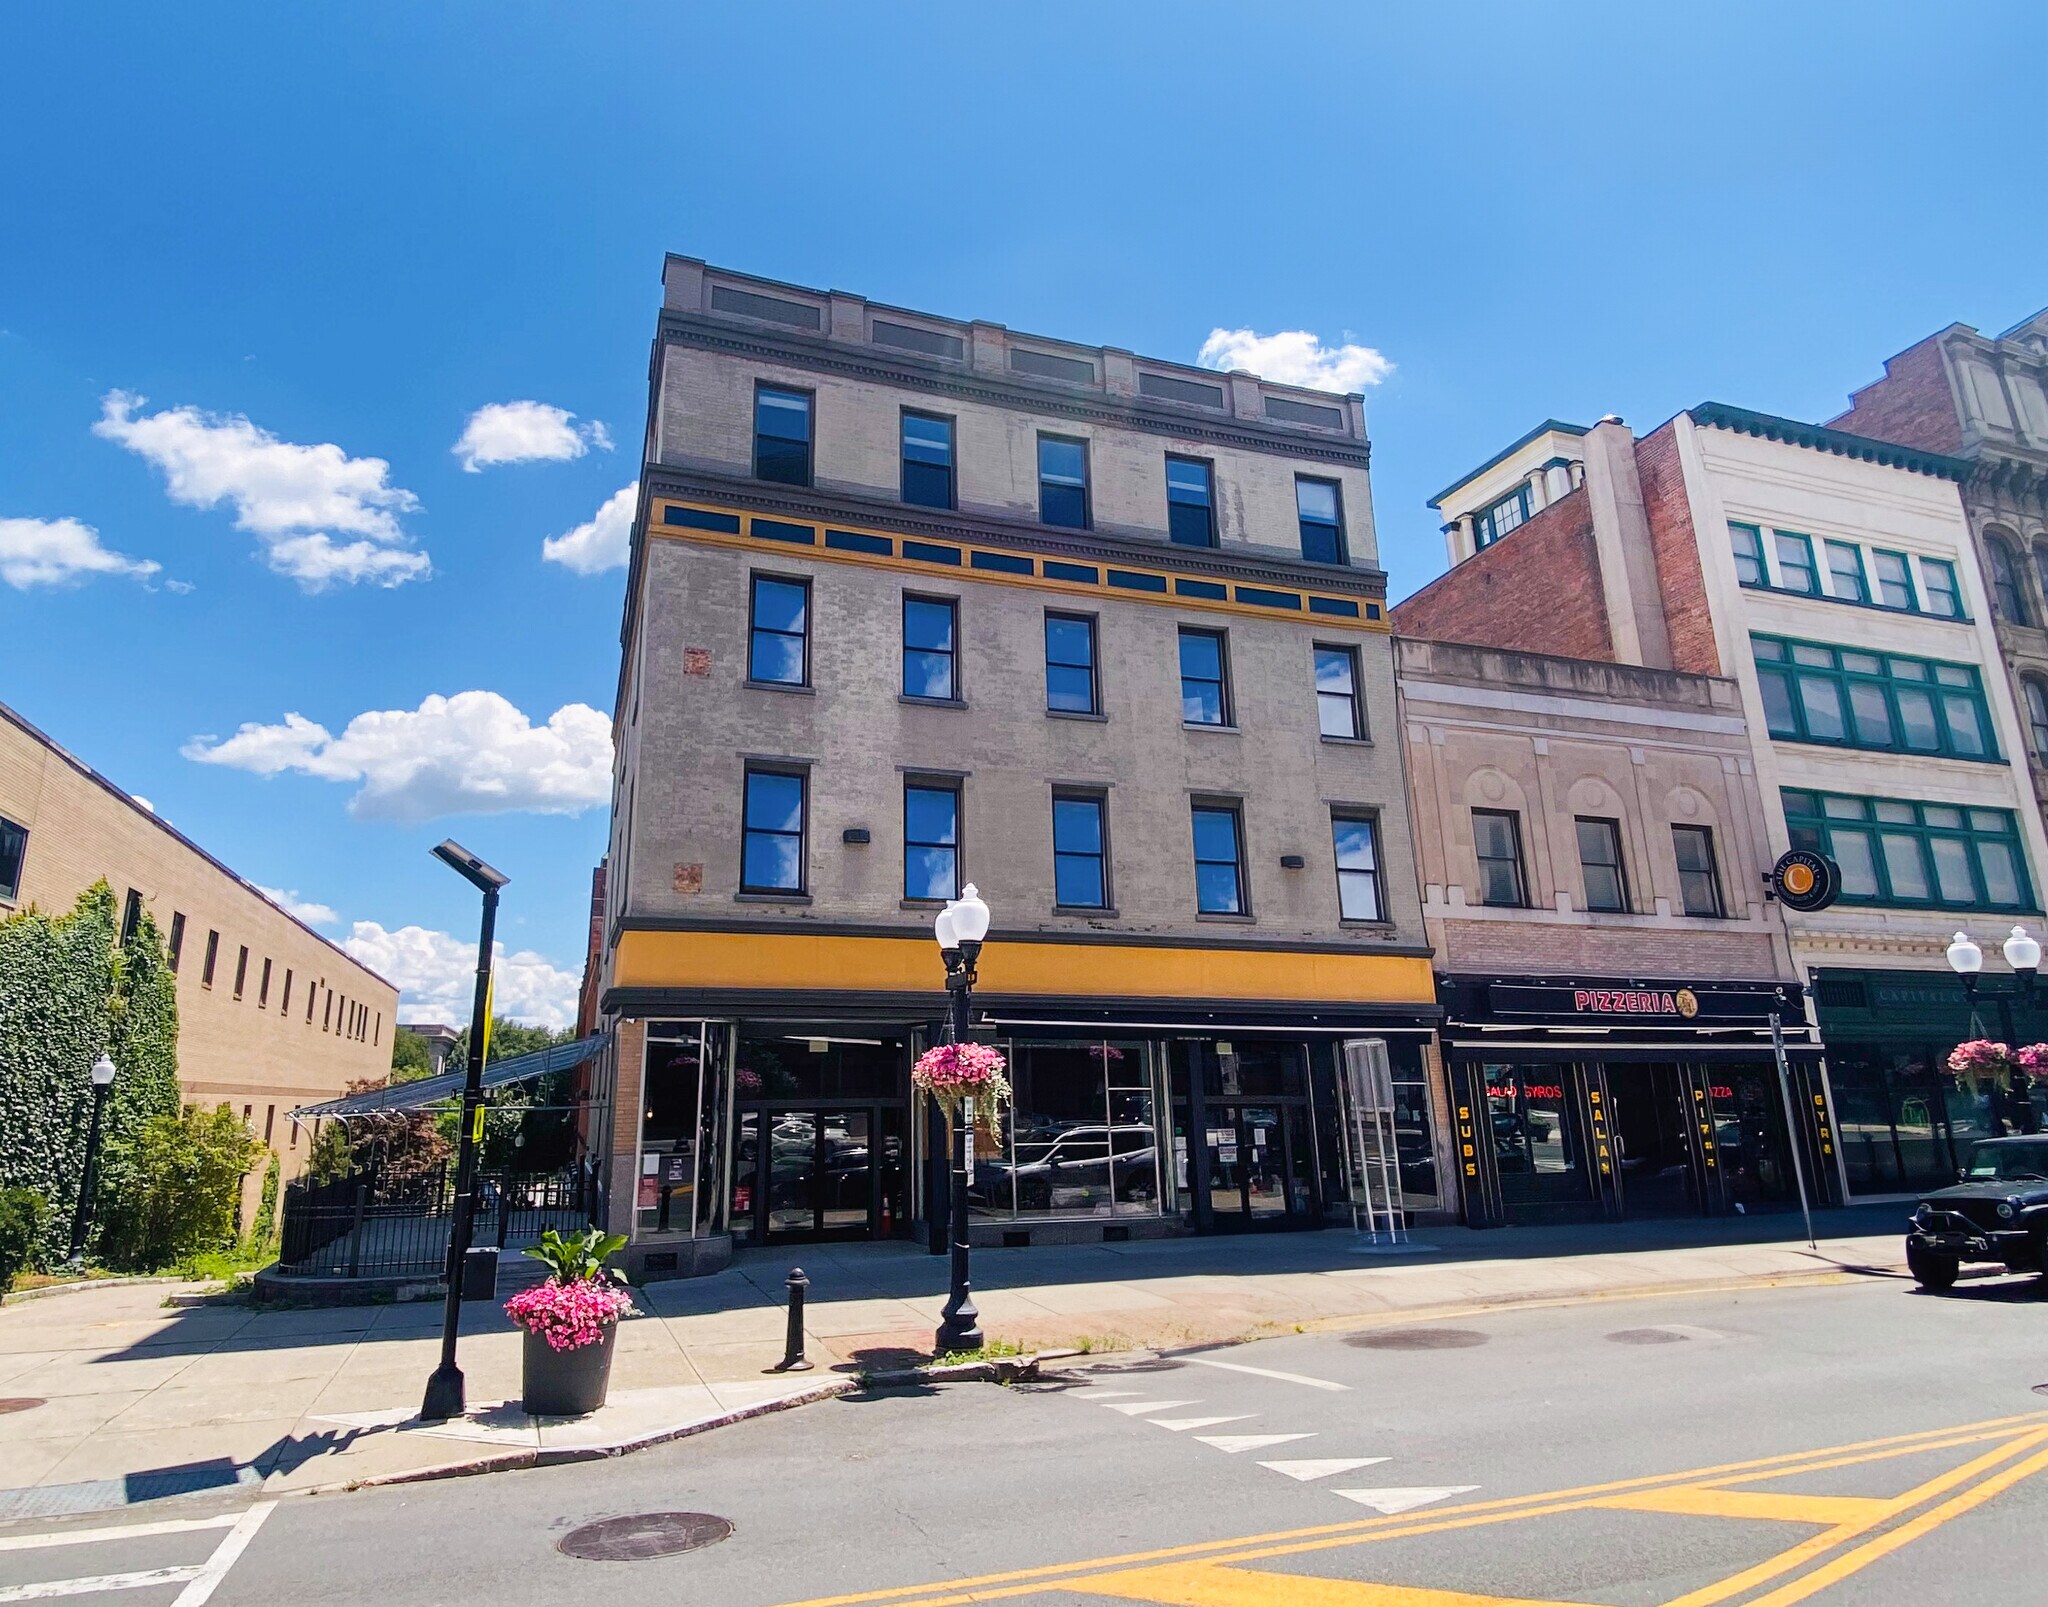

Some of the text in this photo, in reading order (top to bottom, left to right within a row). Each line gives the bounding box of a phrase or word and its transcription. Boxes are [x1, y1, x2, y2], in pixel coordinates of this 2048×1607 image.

[1785, 855, 1820, 875] CAPITAL
[1788, 867, 1806, 890] C
[1574, 990, 1677, 1013] PIZZERIA
[1523, 1085, 1563, 1098] GYROS
[1459, 1106, 1476, 1176] SUBS
